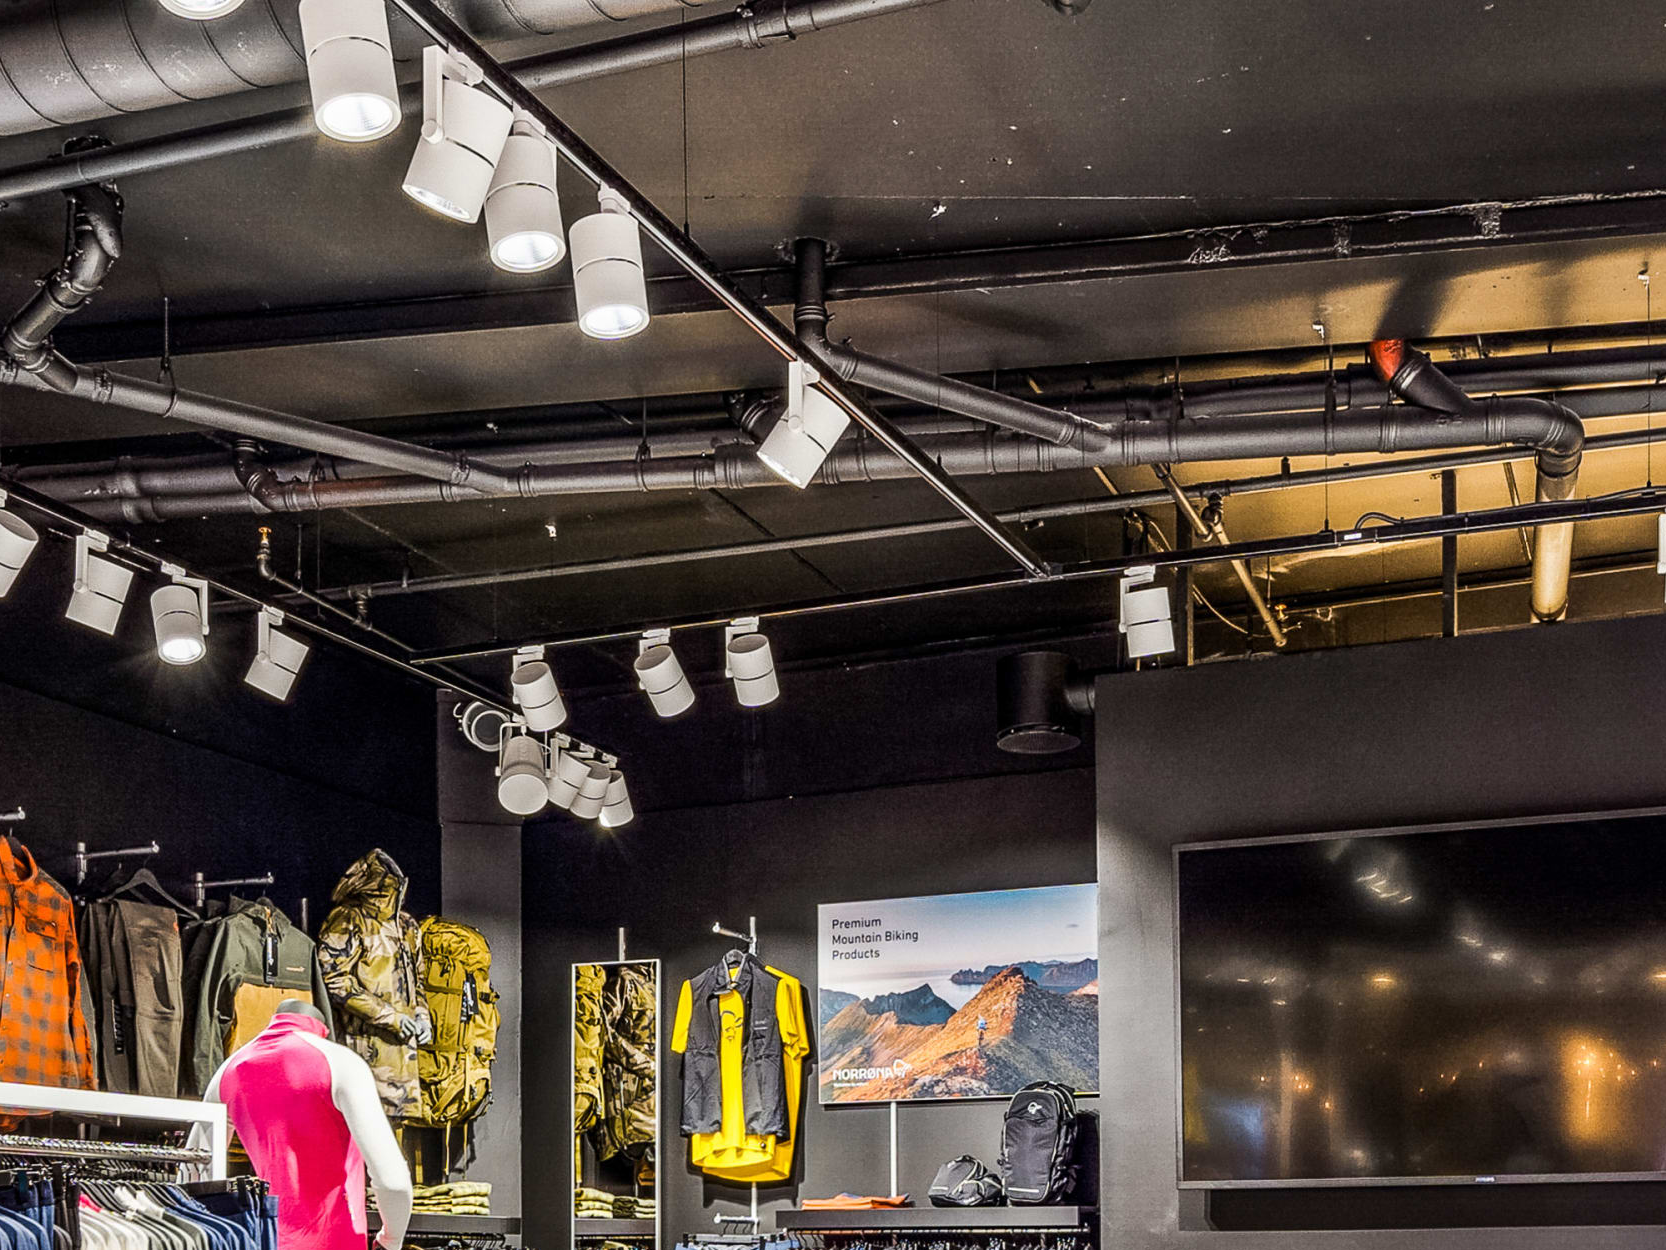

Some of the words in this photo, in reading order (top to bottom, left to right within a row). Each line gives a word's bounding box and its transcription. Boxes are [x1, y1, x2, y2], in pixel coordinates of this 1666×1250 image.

[831, 918, 882, 930] Premium
[831, 931, 882, 945] Mountain
[884, 929, 919, 942] Biking
[831, 948, 881, 960] Products
[832, 1067, 894, 1081] NORRØNA
